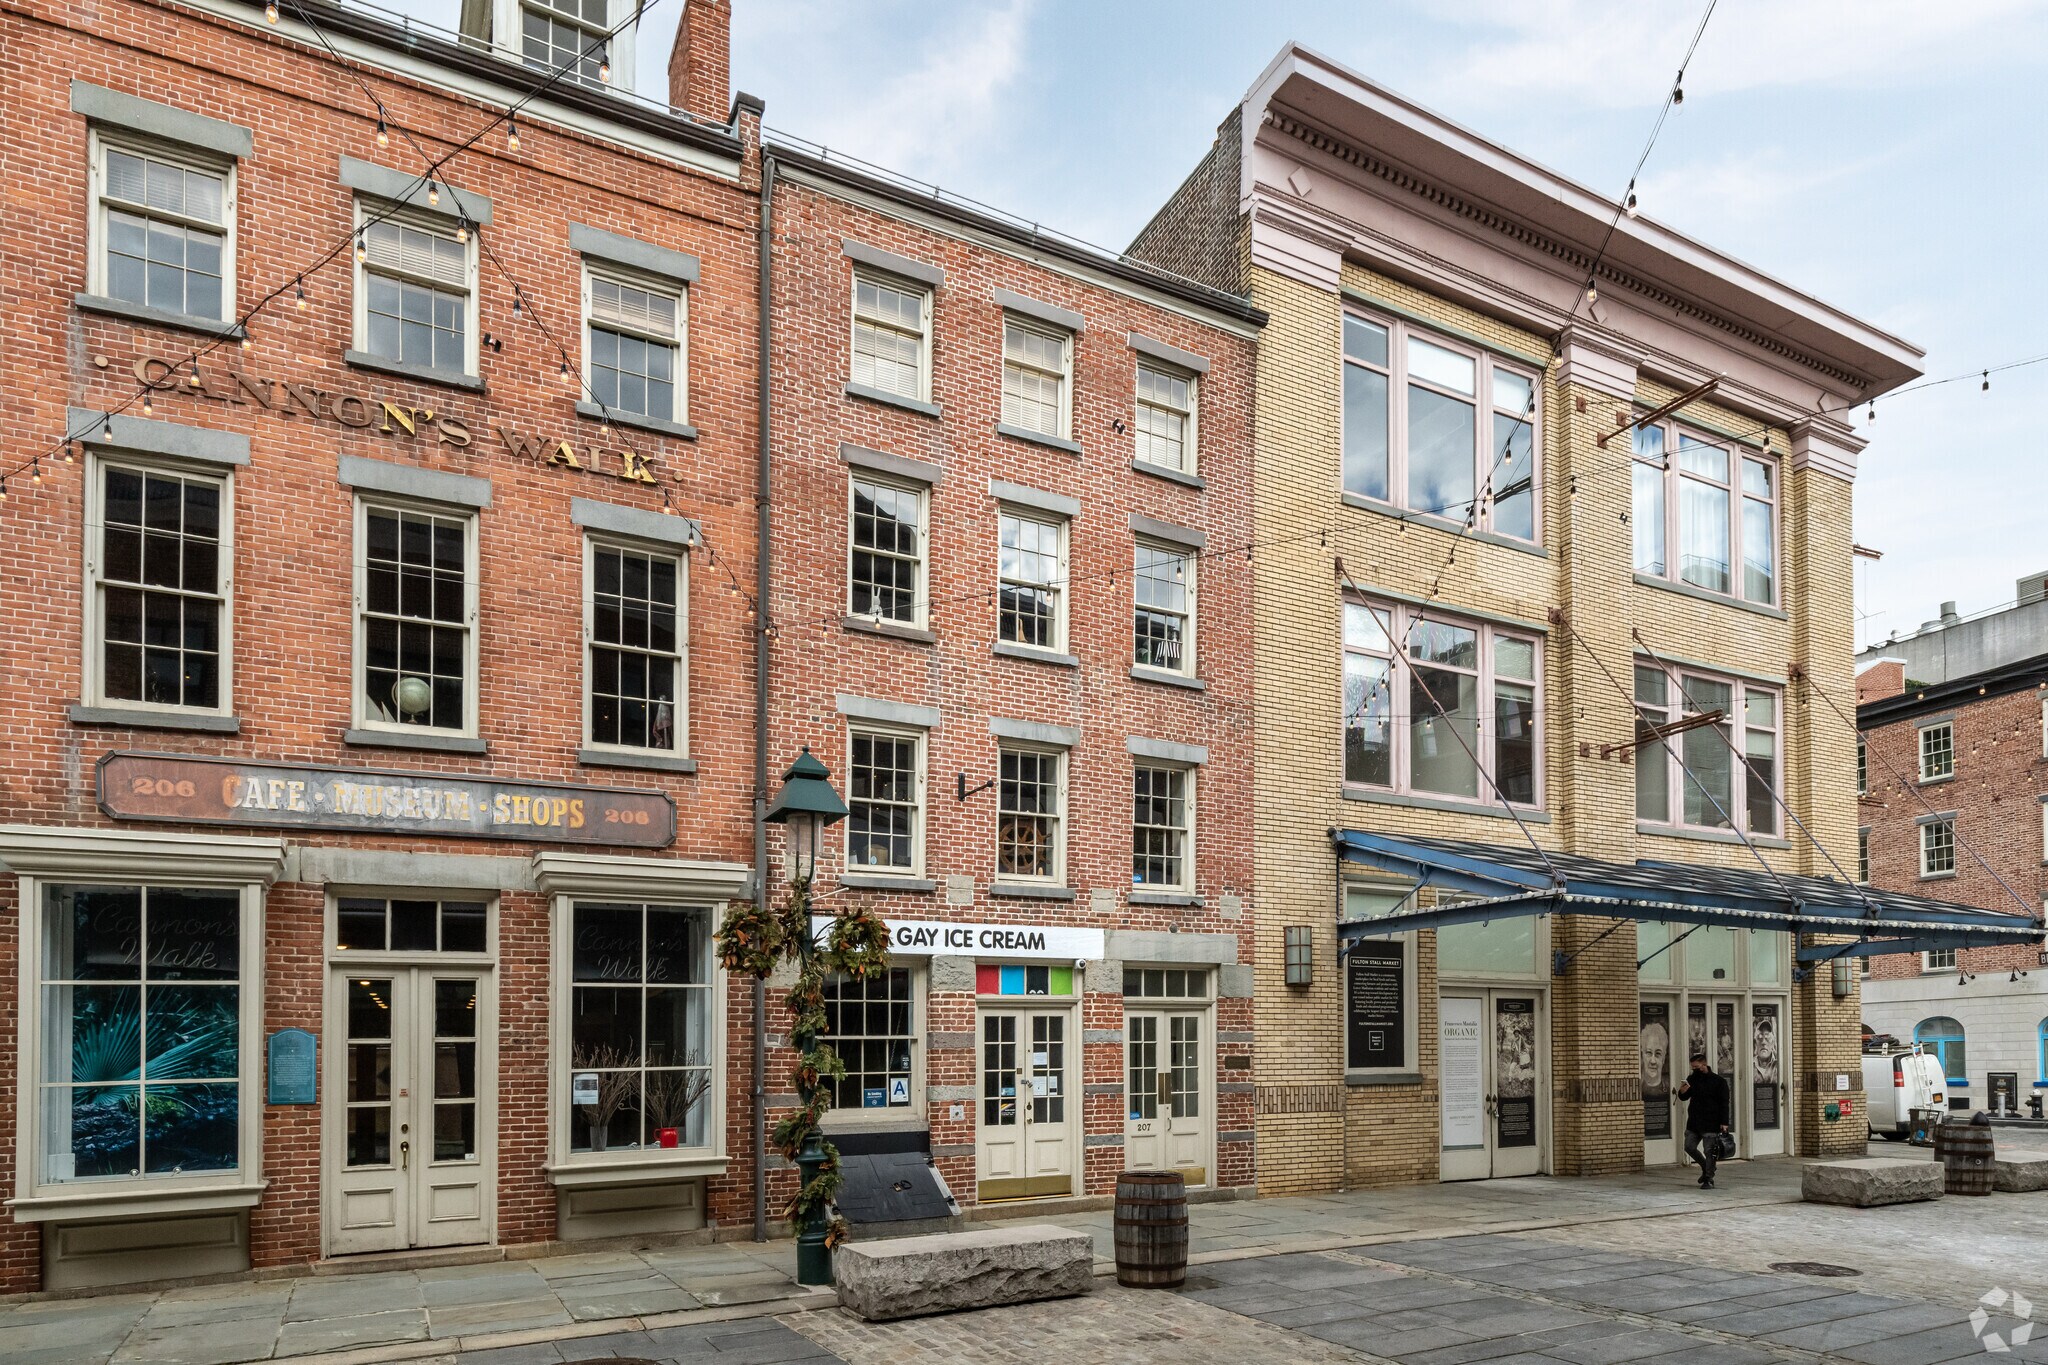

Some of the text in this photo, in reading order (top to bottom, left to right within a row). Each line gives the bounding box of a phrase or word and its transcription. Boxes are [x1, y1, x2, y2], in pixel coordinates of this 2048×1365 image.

[133, 356, 658, 483] CANNON'S WALK
[132, 774, 650, 829] 206 CAFE MUSEUM SHOPS 206
[896, 926, 1046, 951] GAY ICE CREAM
[120, 936, 218, 968] Walk
[1444, 1027, 1479, 1036] ORGANIC
[893, 1080, 906, 1096] A
[1137, 1123, 1152, 1132] 207
